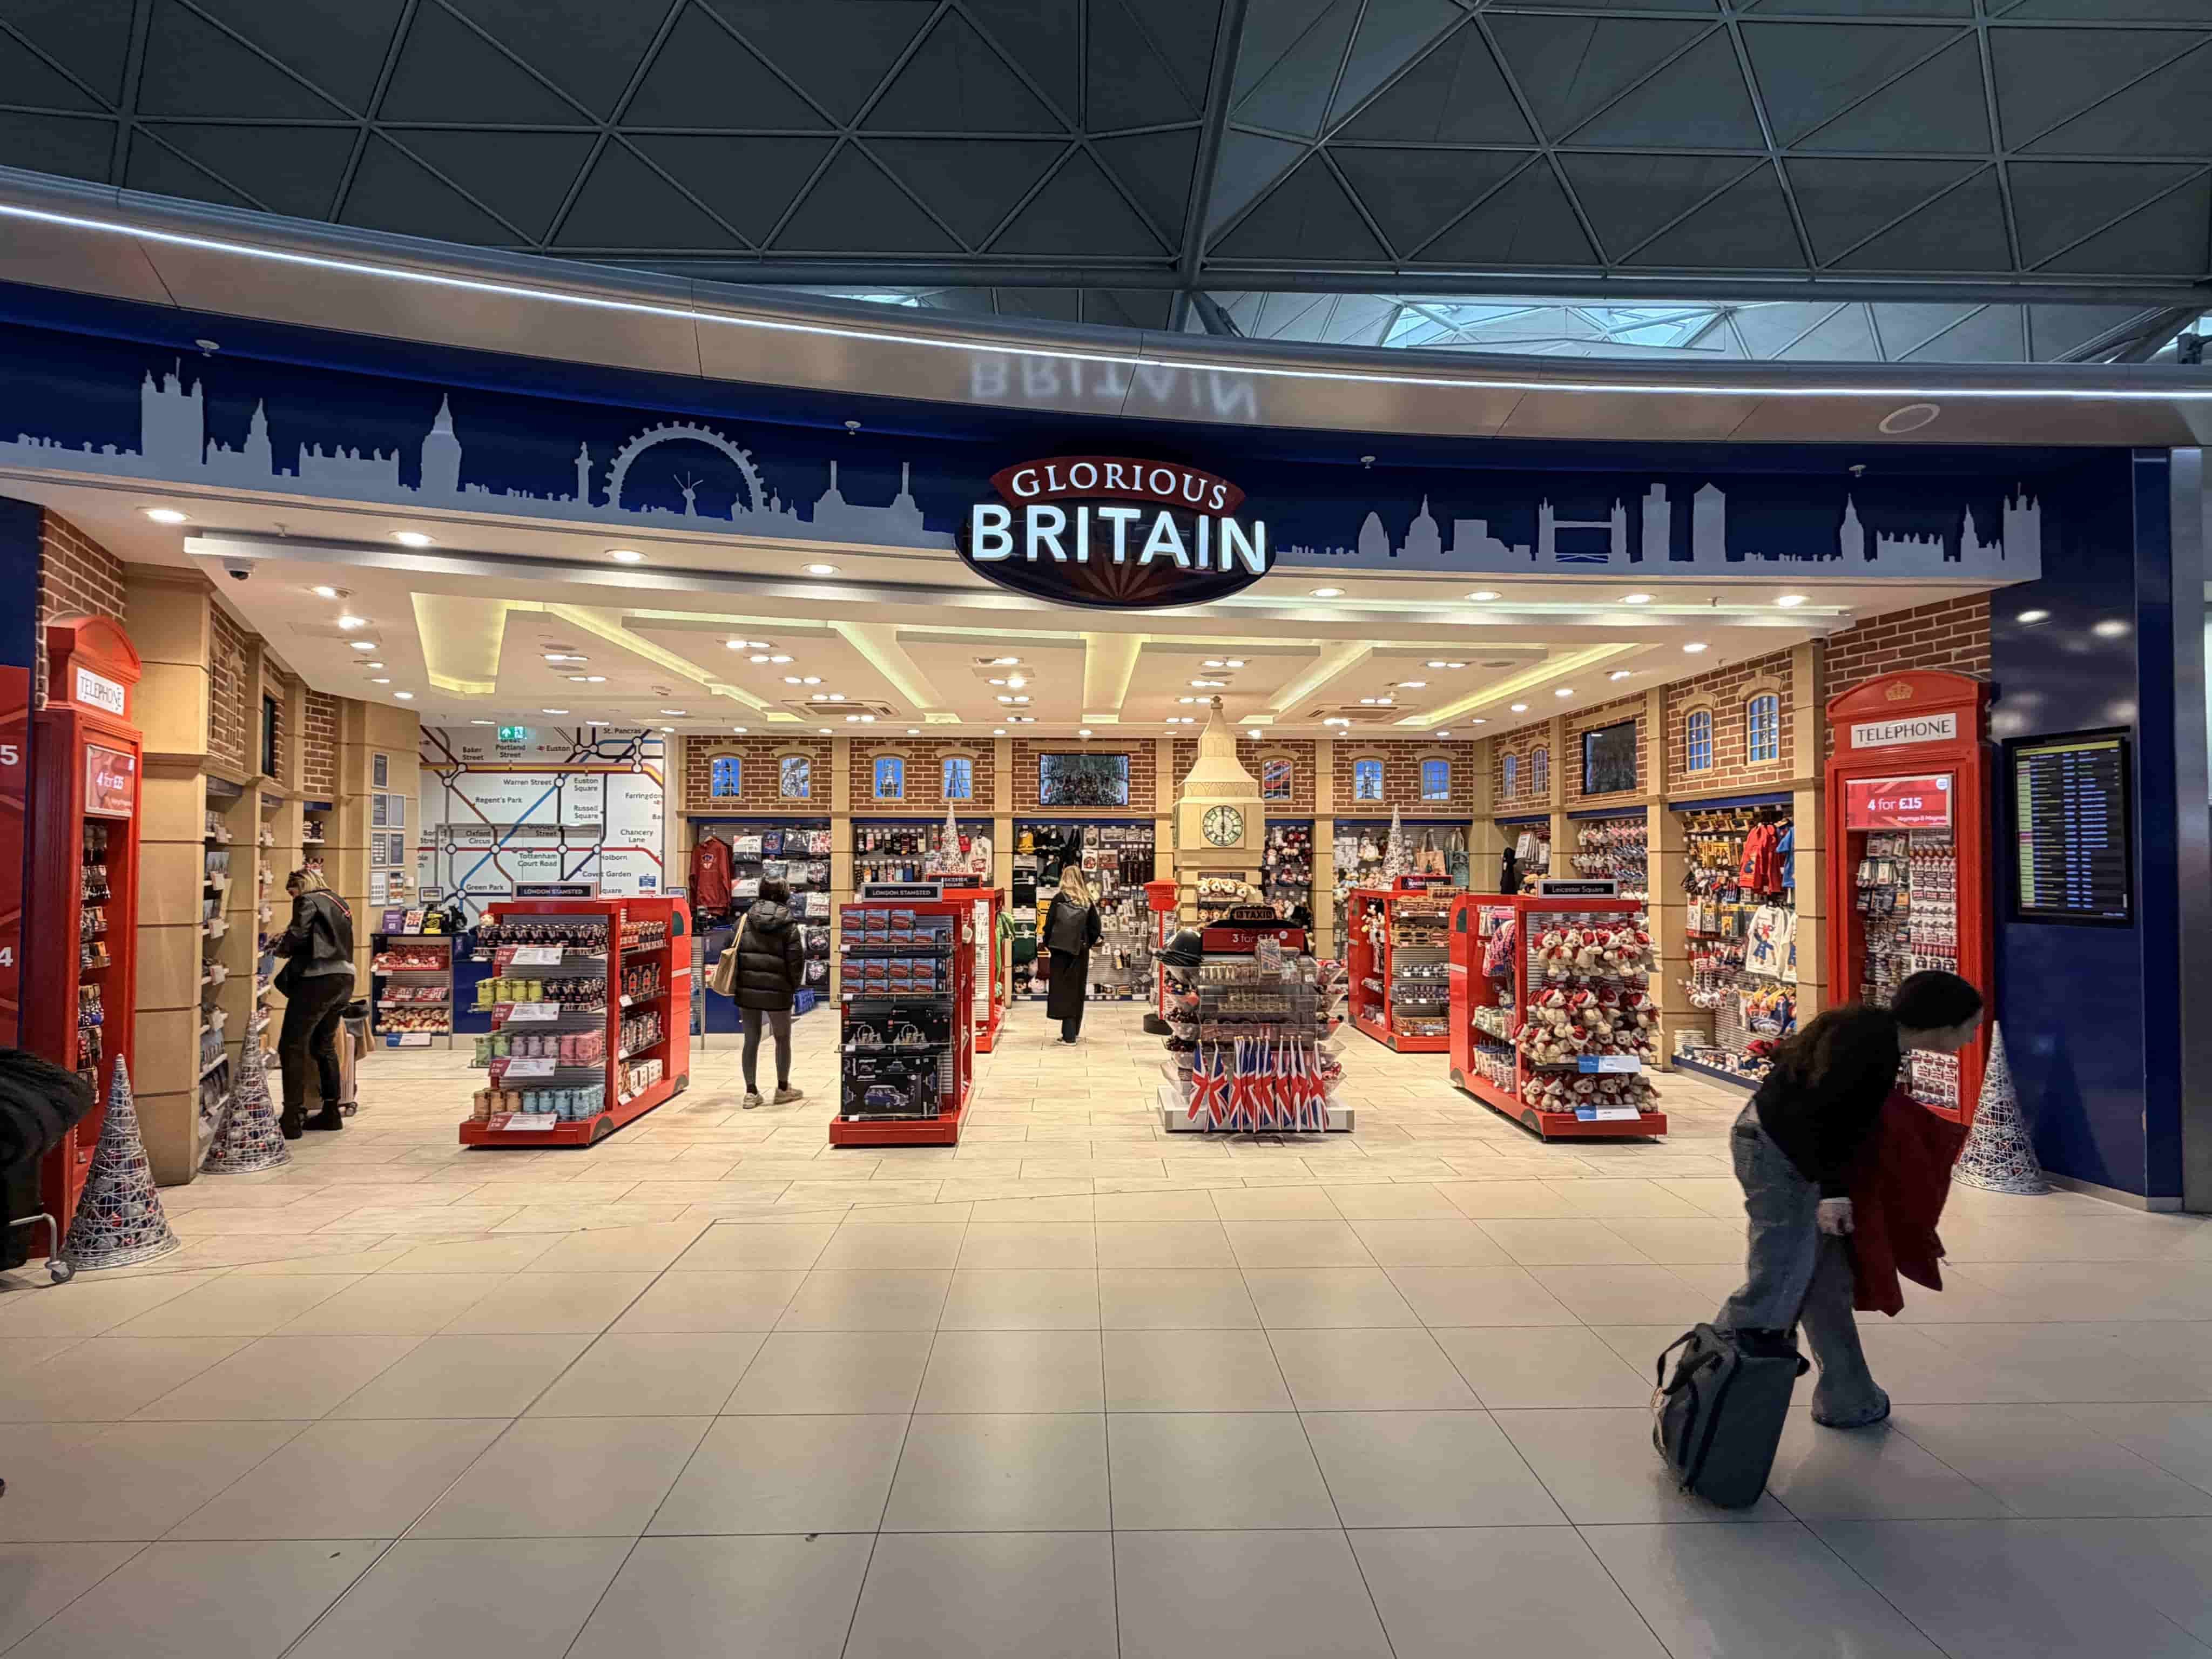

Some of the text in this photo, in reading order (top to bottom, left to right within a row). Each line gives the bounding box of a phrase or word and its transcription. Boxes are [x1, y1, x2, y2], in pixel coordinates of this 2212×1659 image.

[1012, 462, 1226, 510] GLORIOUS
[972, 503, 1267, 575] BRITAIN
[80, 676, 122, 707] TELEPHONE
[1856, 719, 1951, 743] TELEPHONE
[1, 745, 18, 765] 5
[97, 772, 104, 786] 4
[1868, 797, 1923, 811] 4 for £15
[1552, 885, 1580, 893] Leicester
[1232, 934, 1239, 942] 3
[1240, 933, 1253, 943] for
[0, 947, 13, 967] 4
